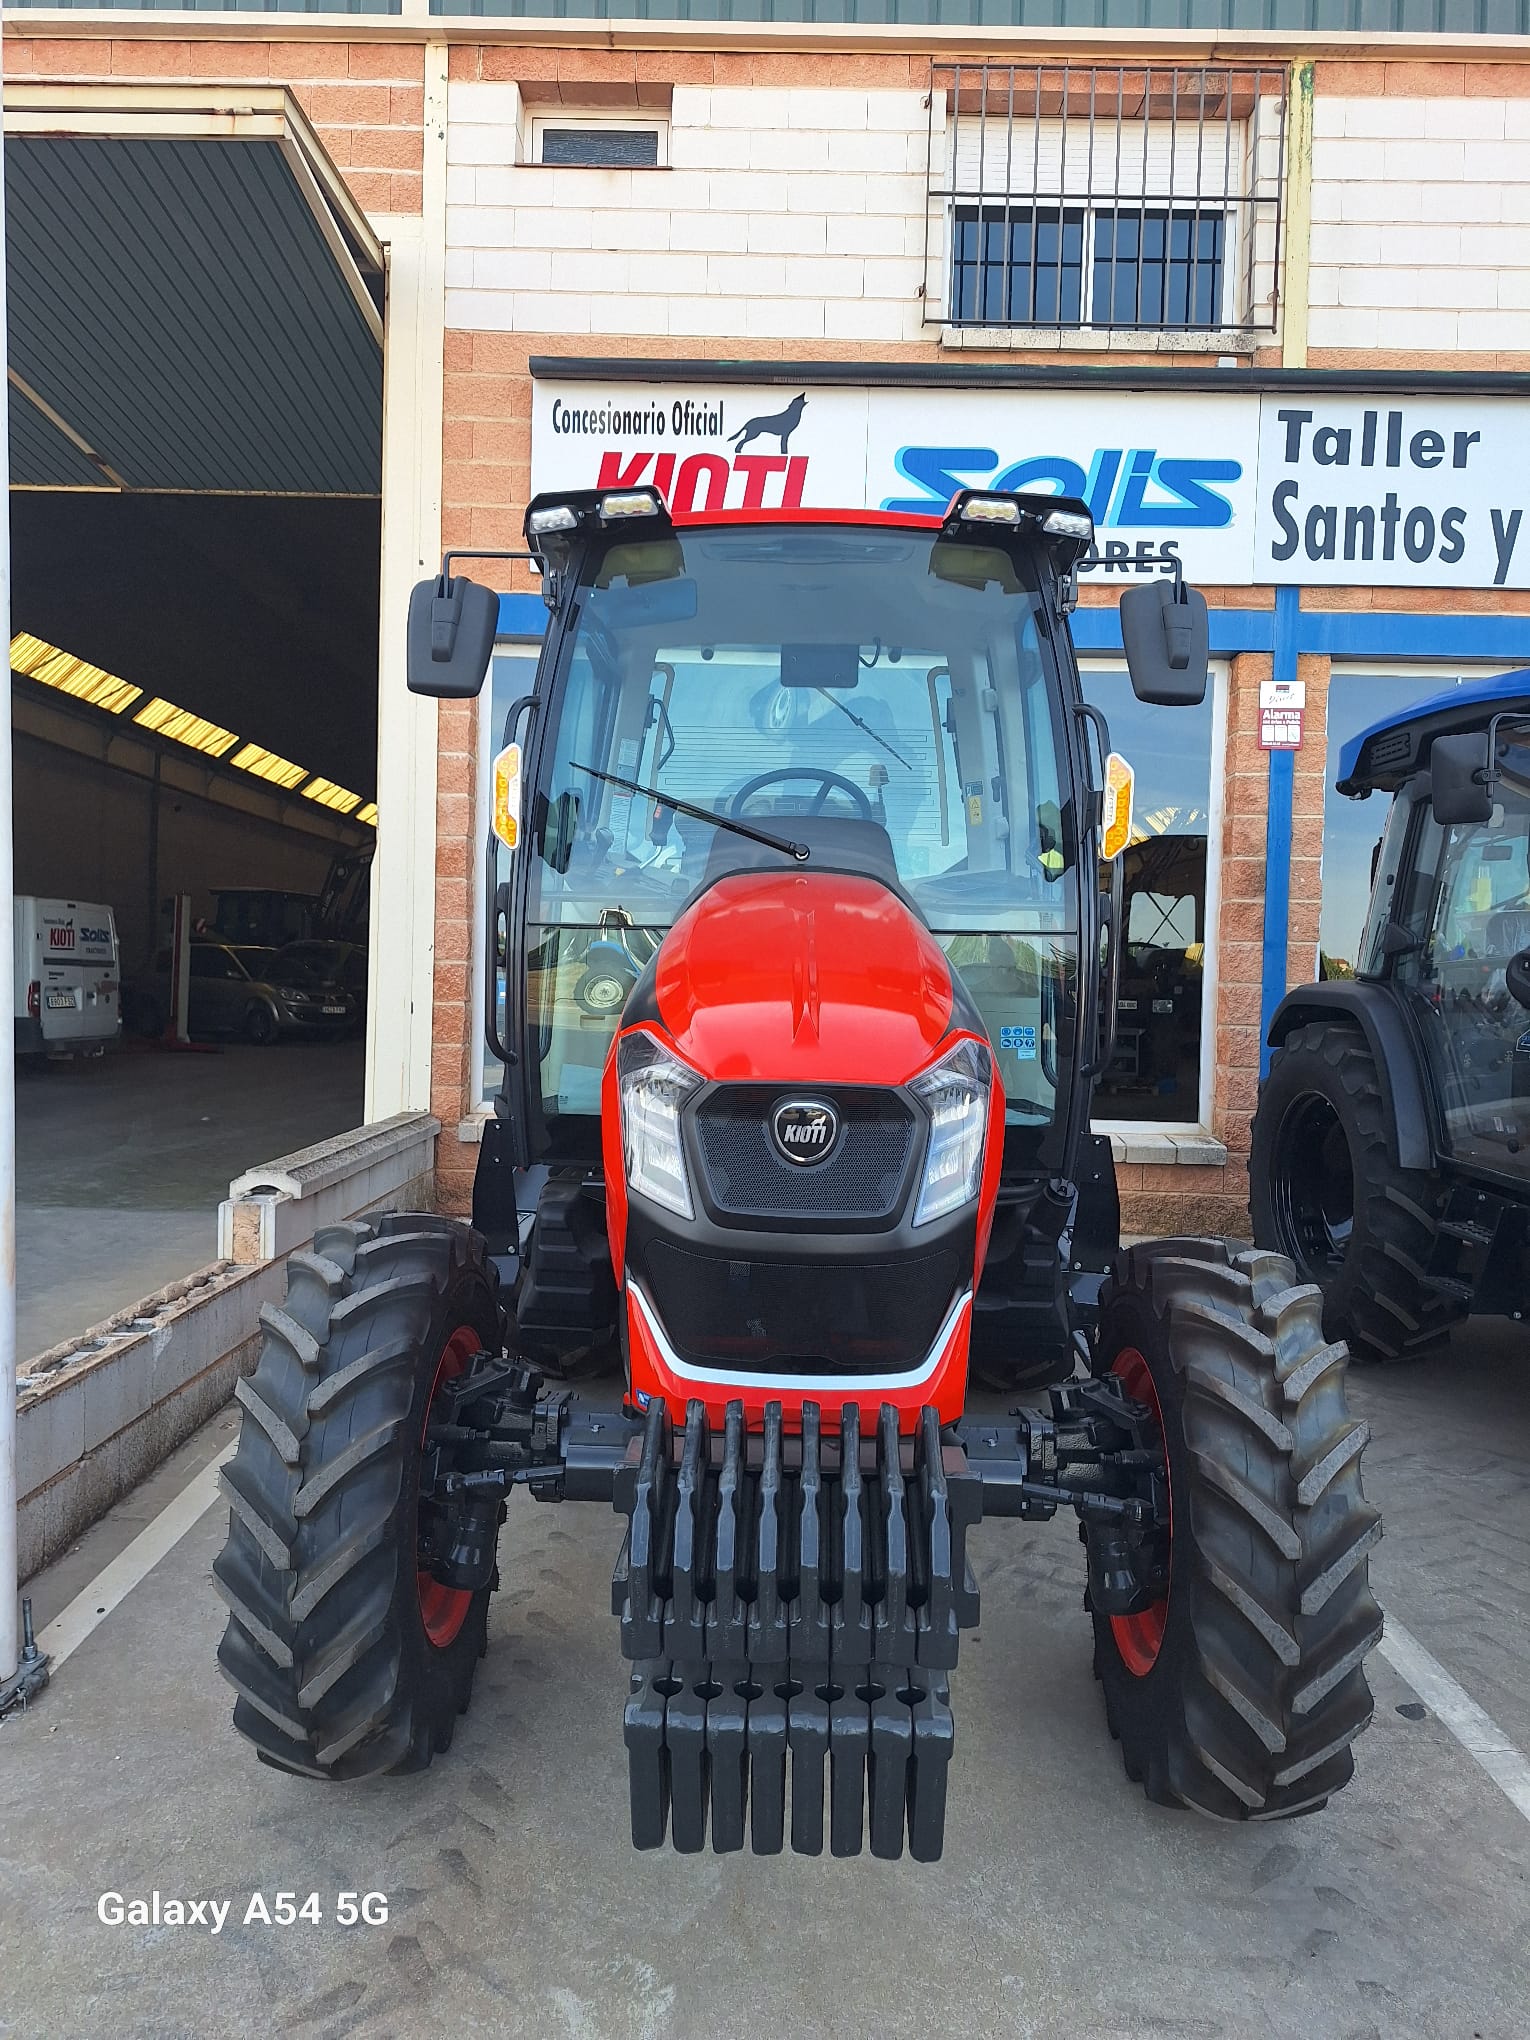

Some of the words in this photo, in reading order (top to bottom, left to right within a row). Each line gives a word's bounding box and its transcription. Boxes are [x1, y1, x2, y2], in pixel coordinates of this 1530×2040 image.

[552, 399, 665, 435] Concesionario
[672, 400, 723, 436] Oficial
[1278, 409, 1480, 468] Taller
[1272, 480, 1467, 564] Santos
[1490, 508, 1523, 585] y
[1262, 708, 1301, 720] Alarma
[50, 928, 75, 947] KIOTI
[784, 1125, 827, 1144] KIOTI
